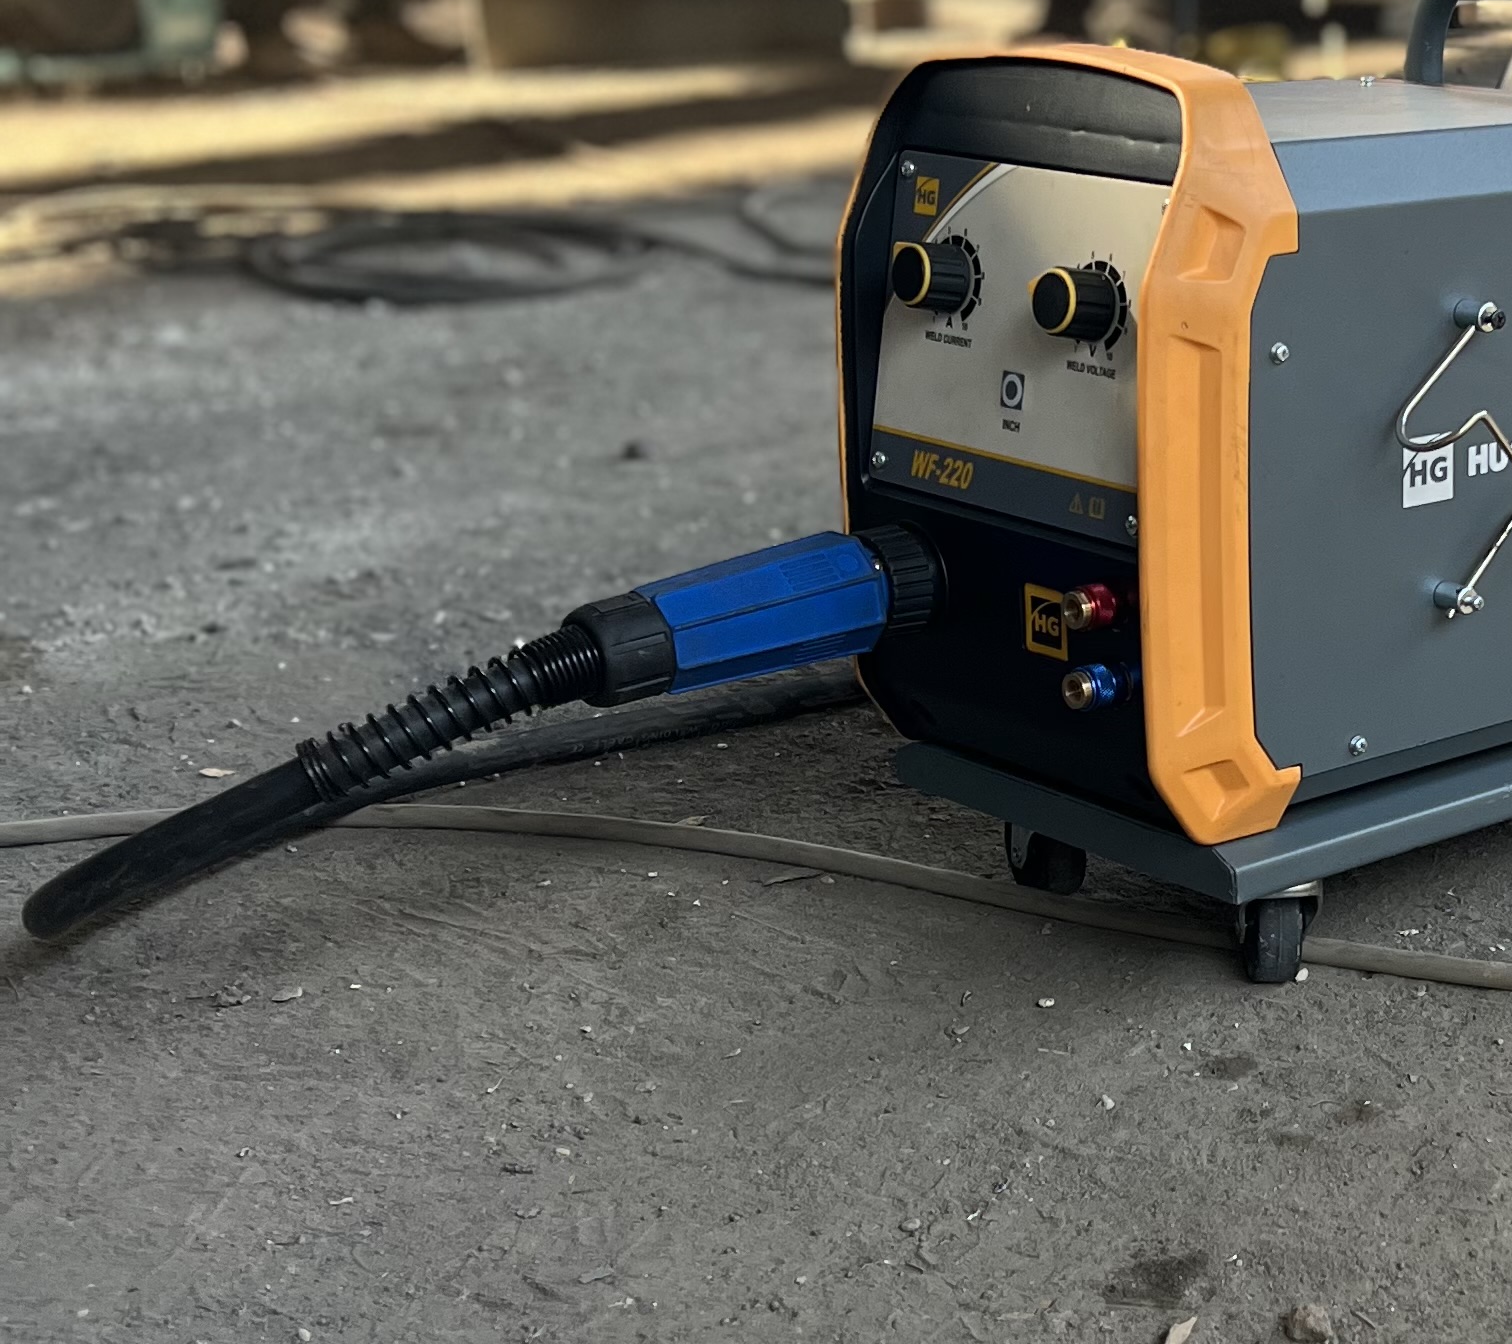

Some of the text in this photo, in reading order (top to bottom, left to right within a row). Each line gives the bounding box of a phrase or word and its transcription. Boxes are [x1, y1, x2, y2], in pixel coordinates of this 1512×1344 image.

[917, 188, 937, 205] HG
[925, 330, 973, 349] WELD CURRENT
[1066, 360, 1116, 380] WELD VOLTAGE
[1002, 418, 1021, 434] INCH
[911, 449, 975, 490] WF-220
[1409, 456, 1448, 488] HG
[1034, 613, 1060, 637] HG
